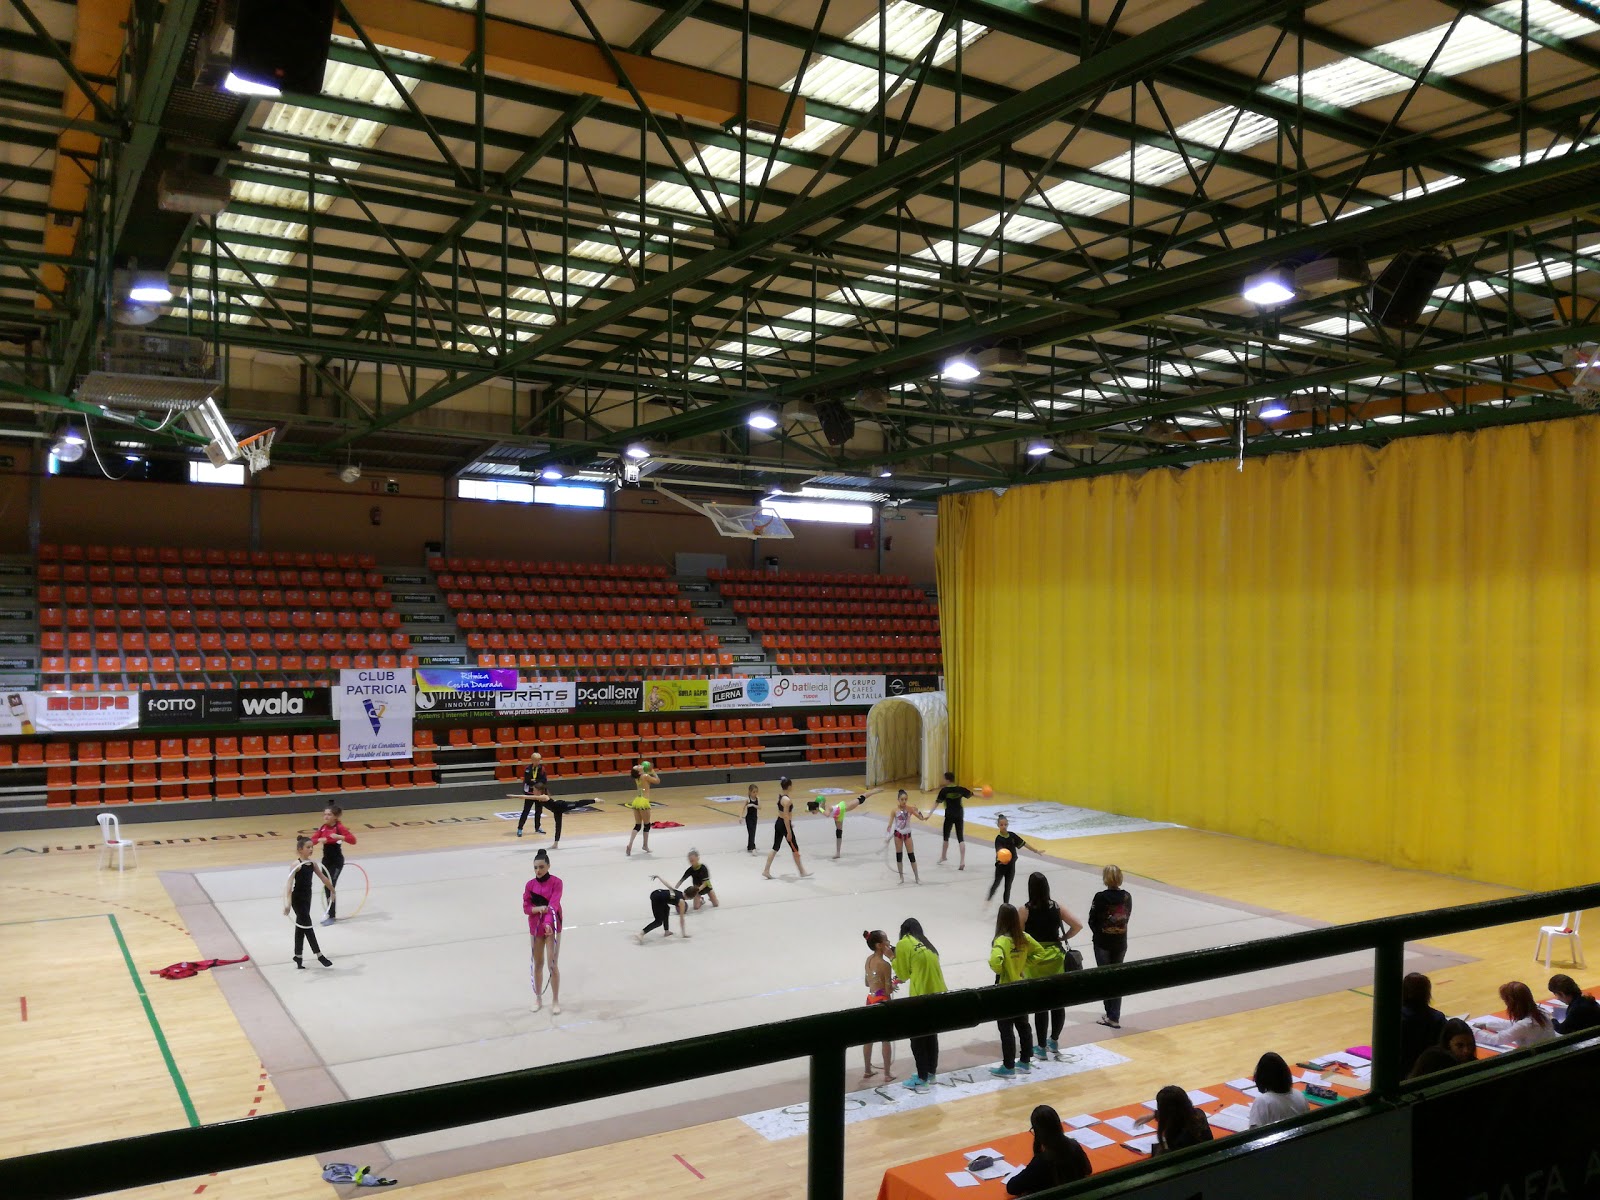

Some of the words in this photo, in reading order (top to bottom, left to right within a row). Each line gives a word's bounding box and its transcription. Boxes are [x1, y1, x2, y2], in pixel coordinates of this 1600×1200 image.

[358, 671, 395, 682] CLUB
[346, 684, 407, 696] PATRICIA
[447, 680, 470, 689] Costa
[470, 680, 504, 689] Daurada
[499, 690, 568, 702] PRATS
[714, 689, 742, 702] ILERNA
[242, 691, 304, 715] wala
[501, 701, 565, 709] ADVOCATS
[417, 711, 441, 720] Systems
[473, 710, 495, 718] Market
[499, 708, 569, 717] www.pratsadvocats.com
[363, 815, 489, 830] Lleida
